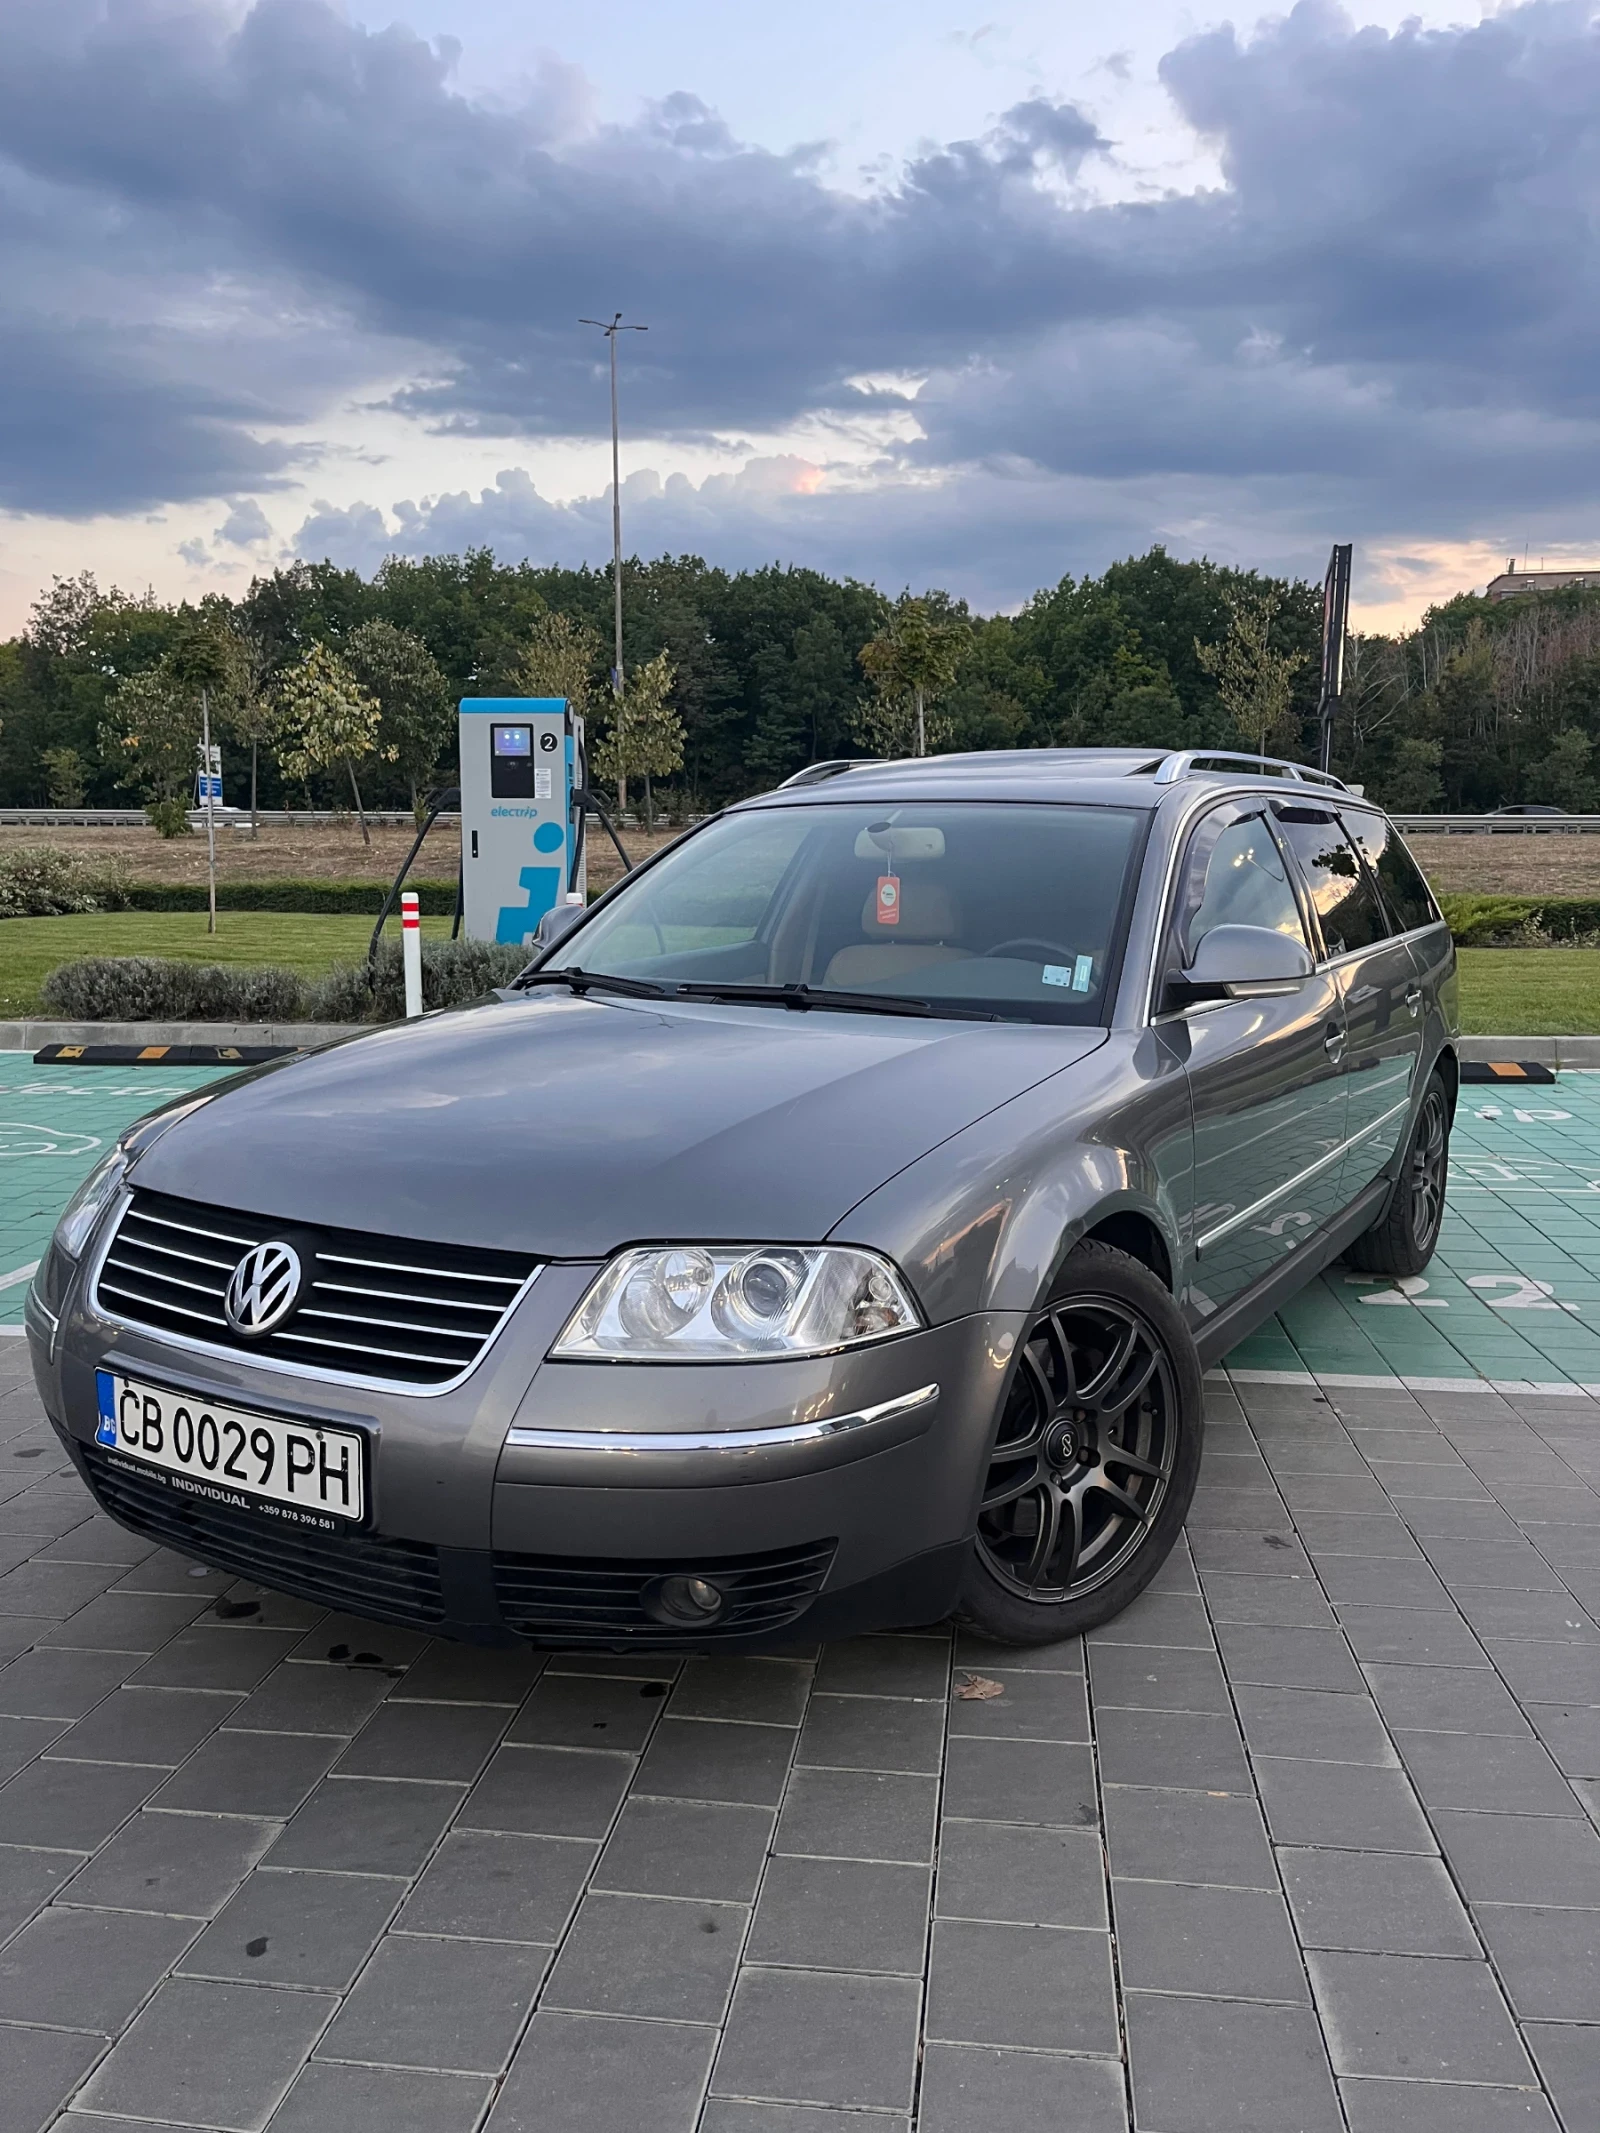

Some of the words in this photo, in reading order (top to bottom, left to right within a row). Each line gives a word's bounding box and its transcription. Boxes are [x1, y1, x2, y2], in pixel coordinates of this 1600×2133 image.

[543, 735, 554, 749] 2
[491, 806, 538, 819] electrip
[103, 1414, 116, 1434] BG
[173, 1407, 275, 1485] 0029
[171, 1476, 250, 1509] INDIVIDUAL
[258, 1504, 280, 1516] +359
[281, 1509, 298, 1521] 878
[300, 1513, 317, 1526] 396
[319, 1518, 335, 1530] 581
